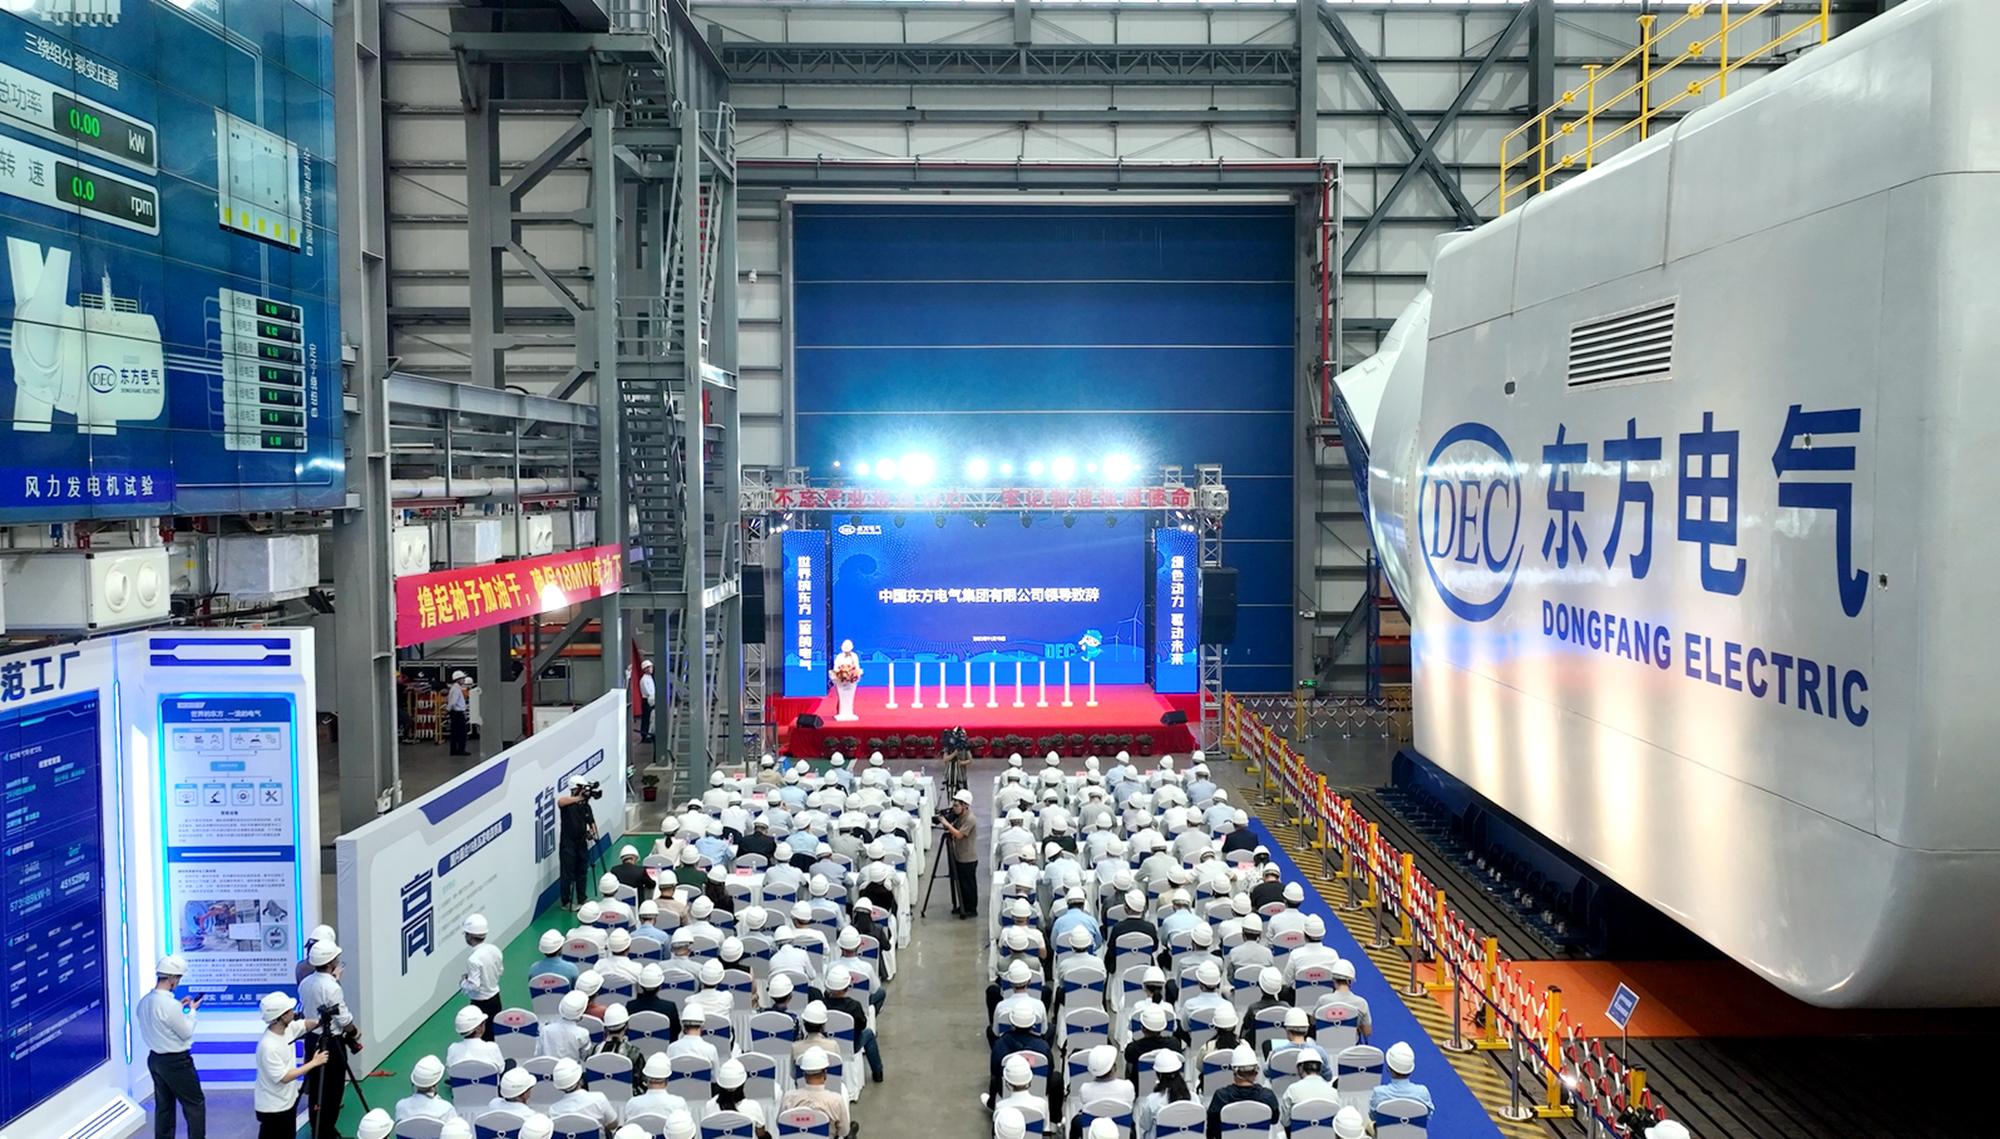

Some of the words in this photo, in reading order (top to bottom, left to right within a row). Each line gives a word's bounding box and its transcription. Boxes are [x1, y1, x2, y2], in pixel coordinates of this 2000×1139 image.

[24, 31, 119, 91] 三绕组分裂变压器
[69, 108, 101, 139] 0.00
[128, 128, 146, 155] kW
[71, 175, 95, 202] 0.0
[131, 195, 153, 217] rpm
[92, 372, 115, 387] DEC
[120, 368, 160, 385] 东方电气
[25, 475, 154, 498] 风力发电机试验
[774, 488, 964, 509] 不忘产业心
[1542, 404, 1869, 618] 东方电气
[1430, 478, 1511, 574] DEC
[798, 556, 812, 616] 世界的东方
[879, 587, 1100, 604] 中国东方电气集团有限公司领导致辞
[1171, 556, 1184, 608] 绿色动力
[798, 620, 812, 671] 一流的电气
[1044, 642, 1077, 659] DEC
[1171, 613, 1184, 665] 驱动未来
[1542, 599, 1671, 670] DONGFANG
[1685, 632, 1869, 727] ELECTRIC
[1, 651, 80, 702] 范工厂
